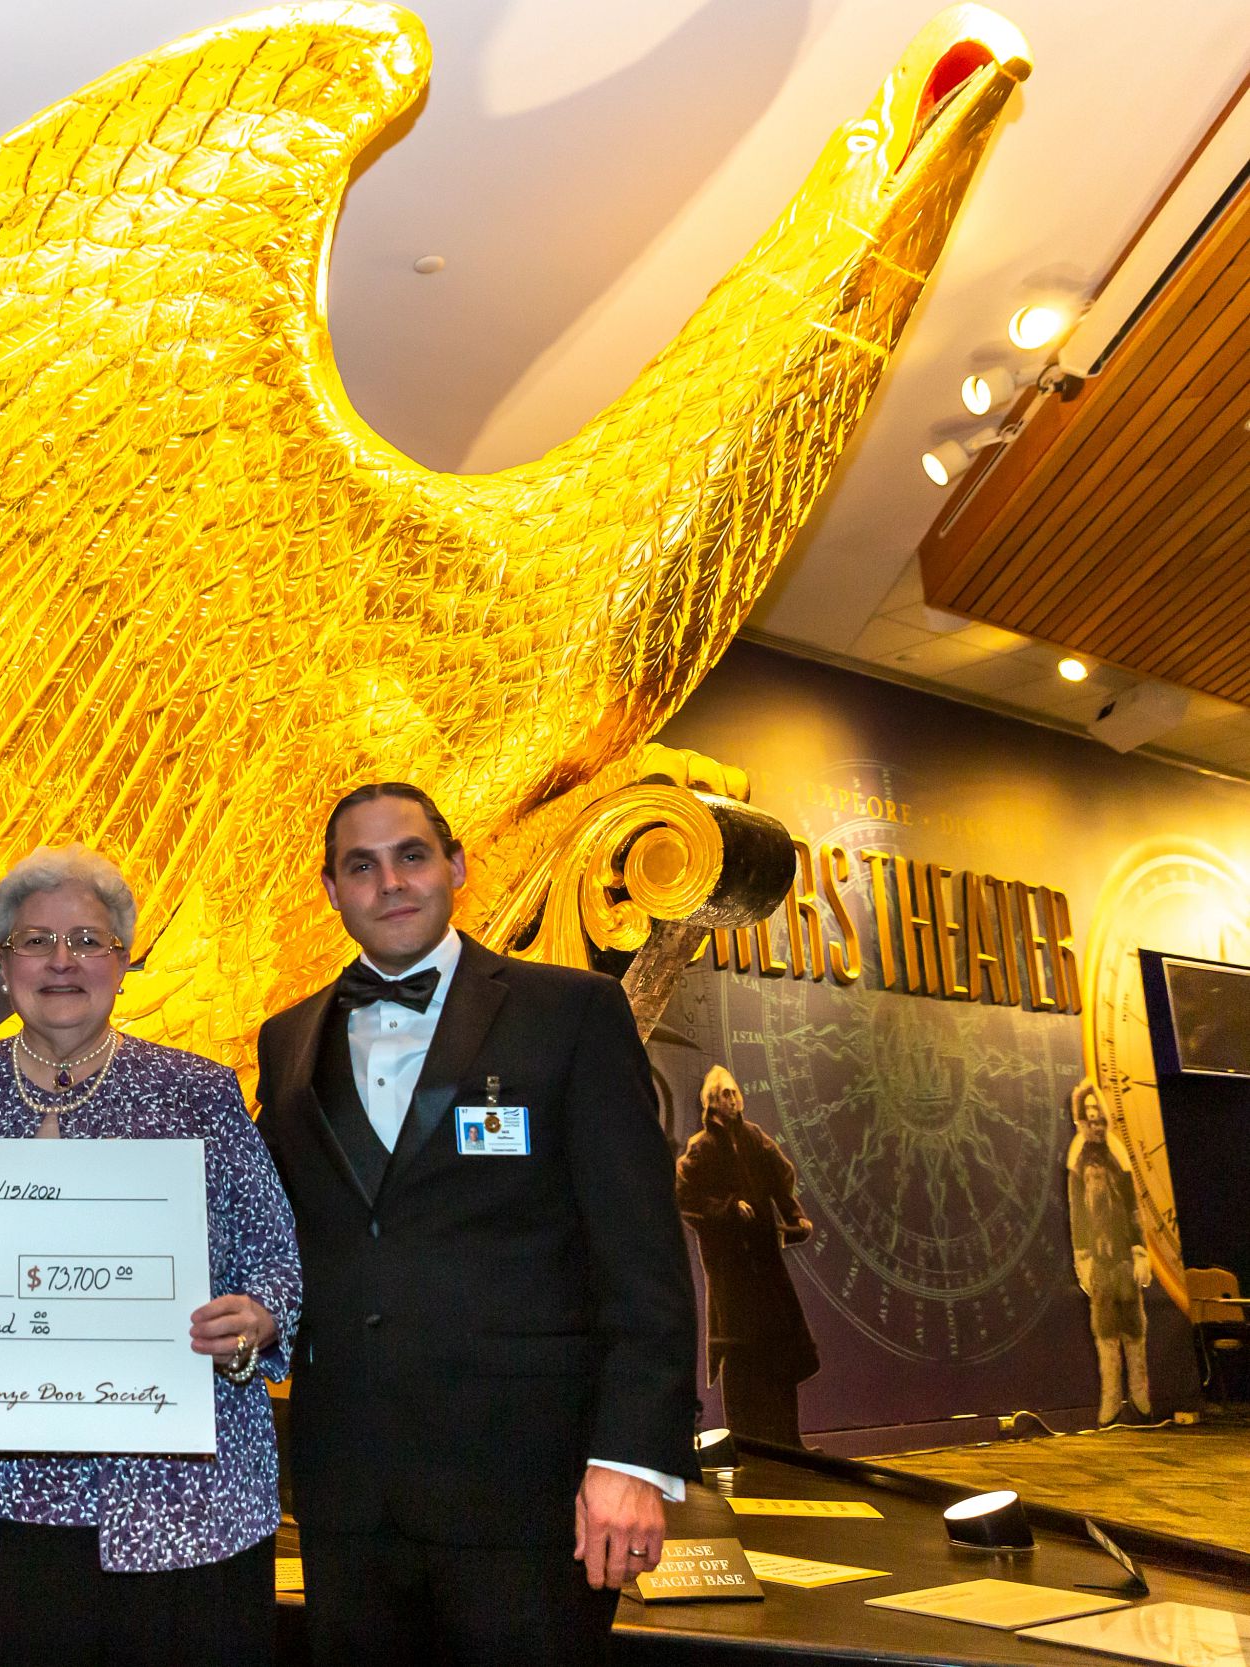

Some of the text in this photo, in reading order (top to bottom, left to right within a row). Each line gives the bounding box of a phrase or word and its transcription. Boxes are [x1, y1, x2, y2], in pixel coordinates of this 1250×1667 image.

[805, 780, 914, 827] EXPLORE
[861, 848, 1082, 1015] THEATER
[47, 1266, 111, 1292] 73,700
[37, 1382, 86, 1401] Door
[95, 1381, 169, 1414] Society
[649, 1573, 747, 1588] EAGLE BASE
[656, 1559, 730, 1573] KEEP OFF
